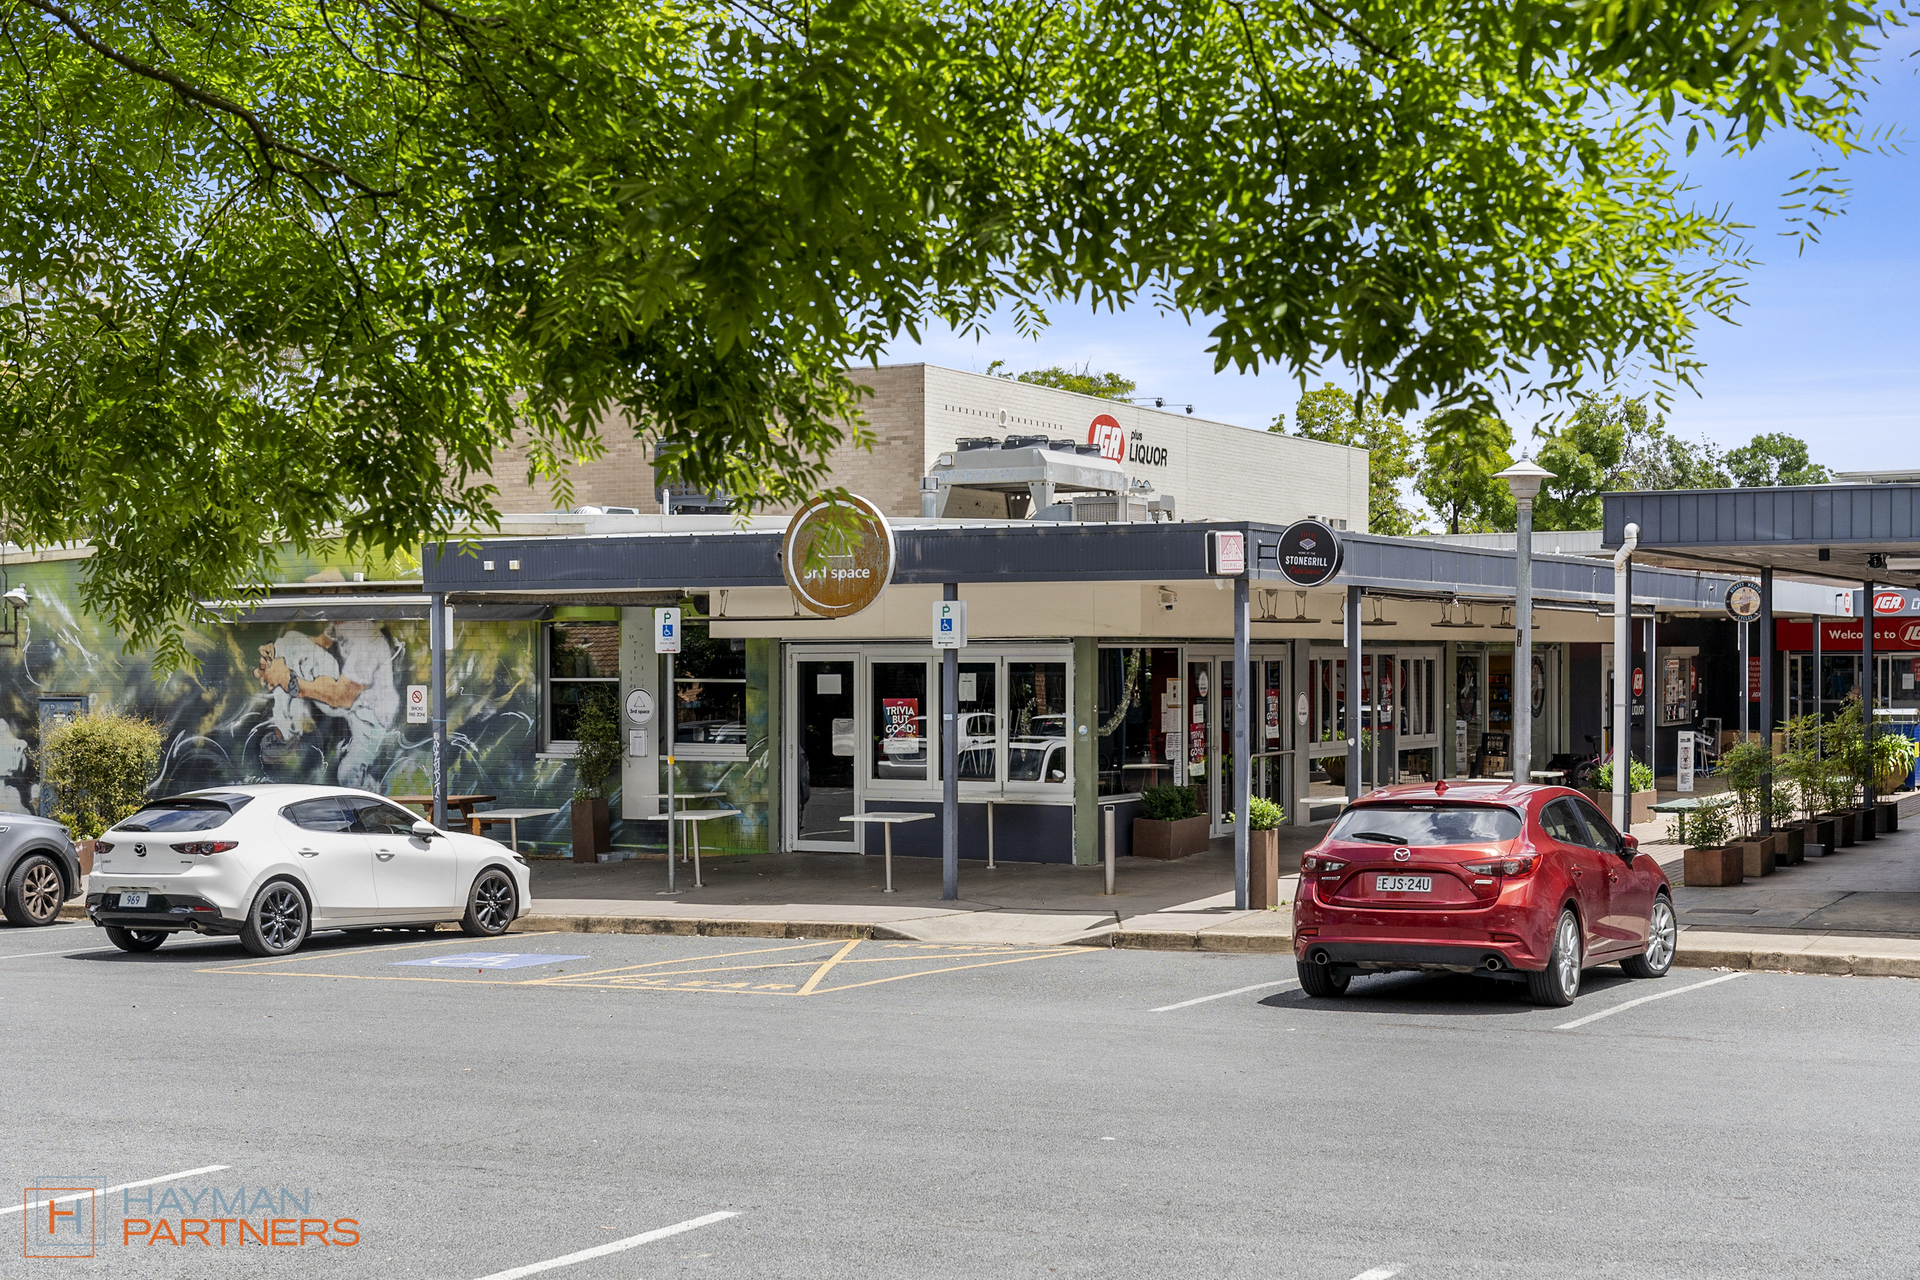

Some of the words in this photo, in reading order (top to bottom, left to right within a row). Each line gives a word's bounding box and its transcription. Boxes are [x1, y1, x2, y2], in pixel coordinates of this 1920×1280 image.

[1130, 429, 1143, 441] plus
[1092, 424, 1121, 459] IGA
[1129, 443, 1168, 467] LIQUOR
[1285, 555, 1328, 567] STONEGRILL
[831, 567, 871, 582] space
[1874, 596, 1902, 609] IGA
[942, 605, 951, 617] P
[664, 612, 672, 623] P
[1828, 630, 1881, 639] Welcoe
[1884, 630, 1896, 639] to
[1903, 626, 1920, 640] IG
[885, 706, 915, 716] TRIVIA
[892, 715, 909, 724] BUT
[1190, 731, 1204, 740] TRIVIA
[1193, 739, 1202, 748] BUT
[126, 895, 141, 905] 969
